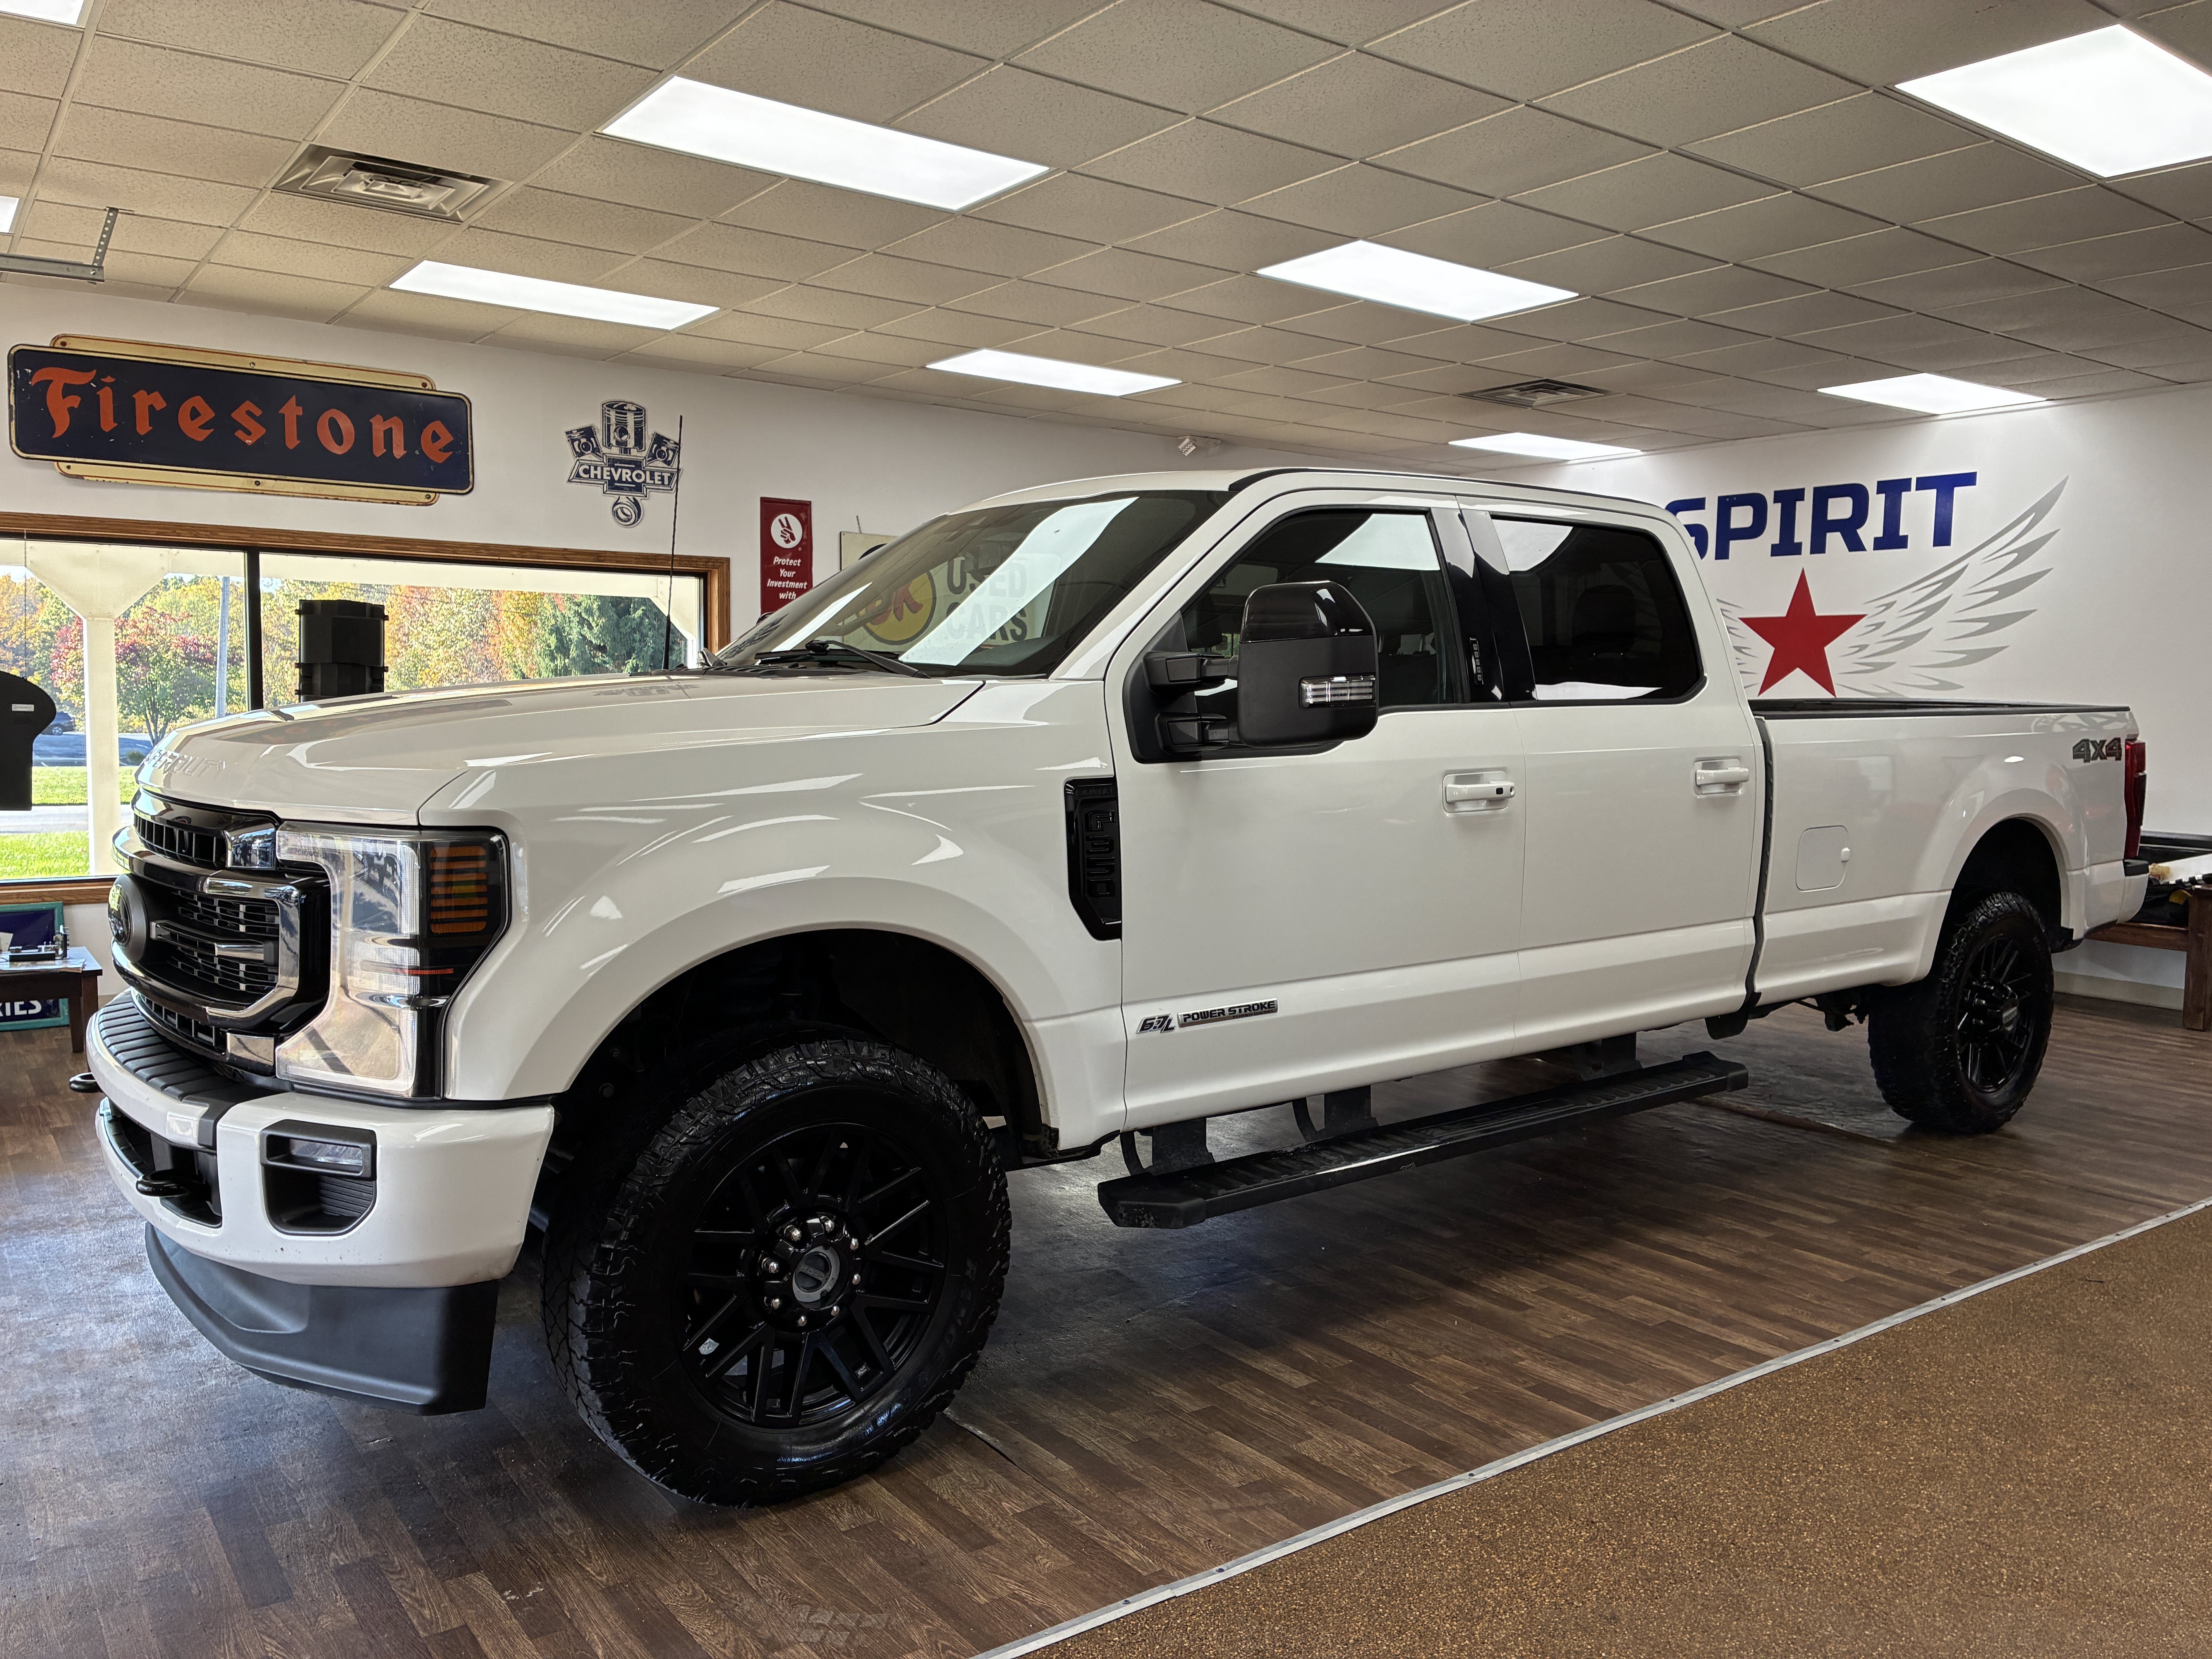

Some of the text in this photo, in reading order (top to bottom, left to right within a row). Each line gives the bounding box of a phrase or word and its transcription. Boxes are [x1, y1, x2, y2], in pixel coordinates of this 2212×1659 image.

[31, 366, 455, 464] Firestone
[578, 465, 671, 485] CHEVROLET
[1664, 471, 1977, 560] SPIRIT
[773, 556, 801, 566] Protect
[780, 568, 796, 578] Your
[767, 578, 808, 589] Investment
[779, 591, 796, 600] with
[946, 601, 1027, 641] CARS
[1183, 1011, 1226, 1023] POWER
[1228, 1000, 1276, 1015] STROKE
